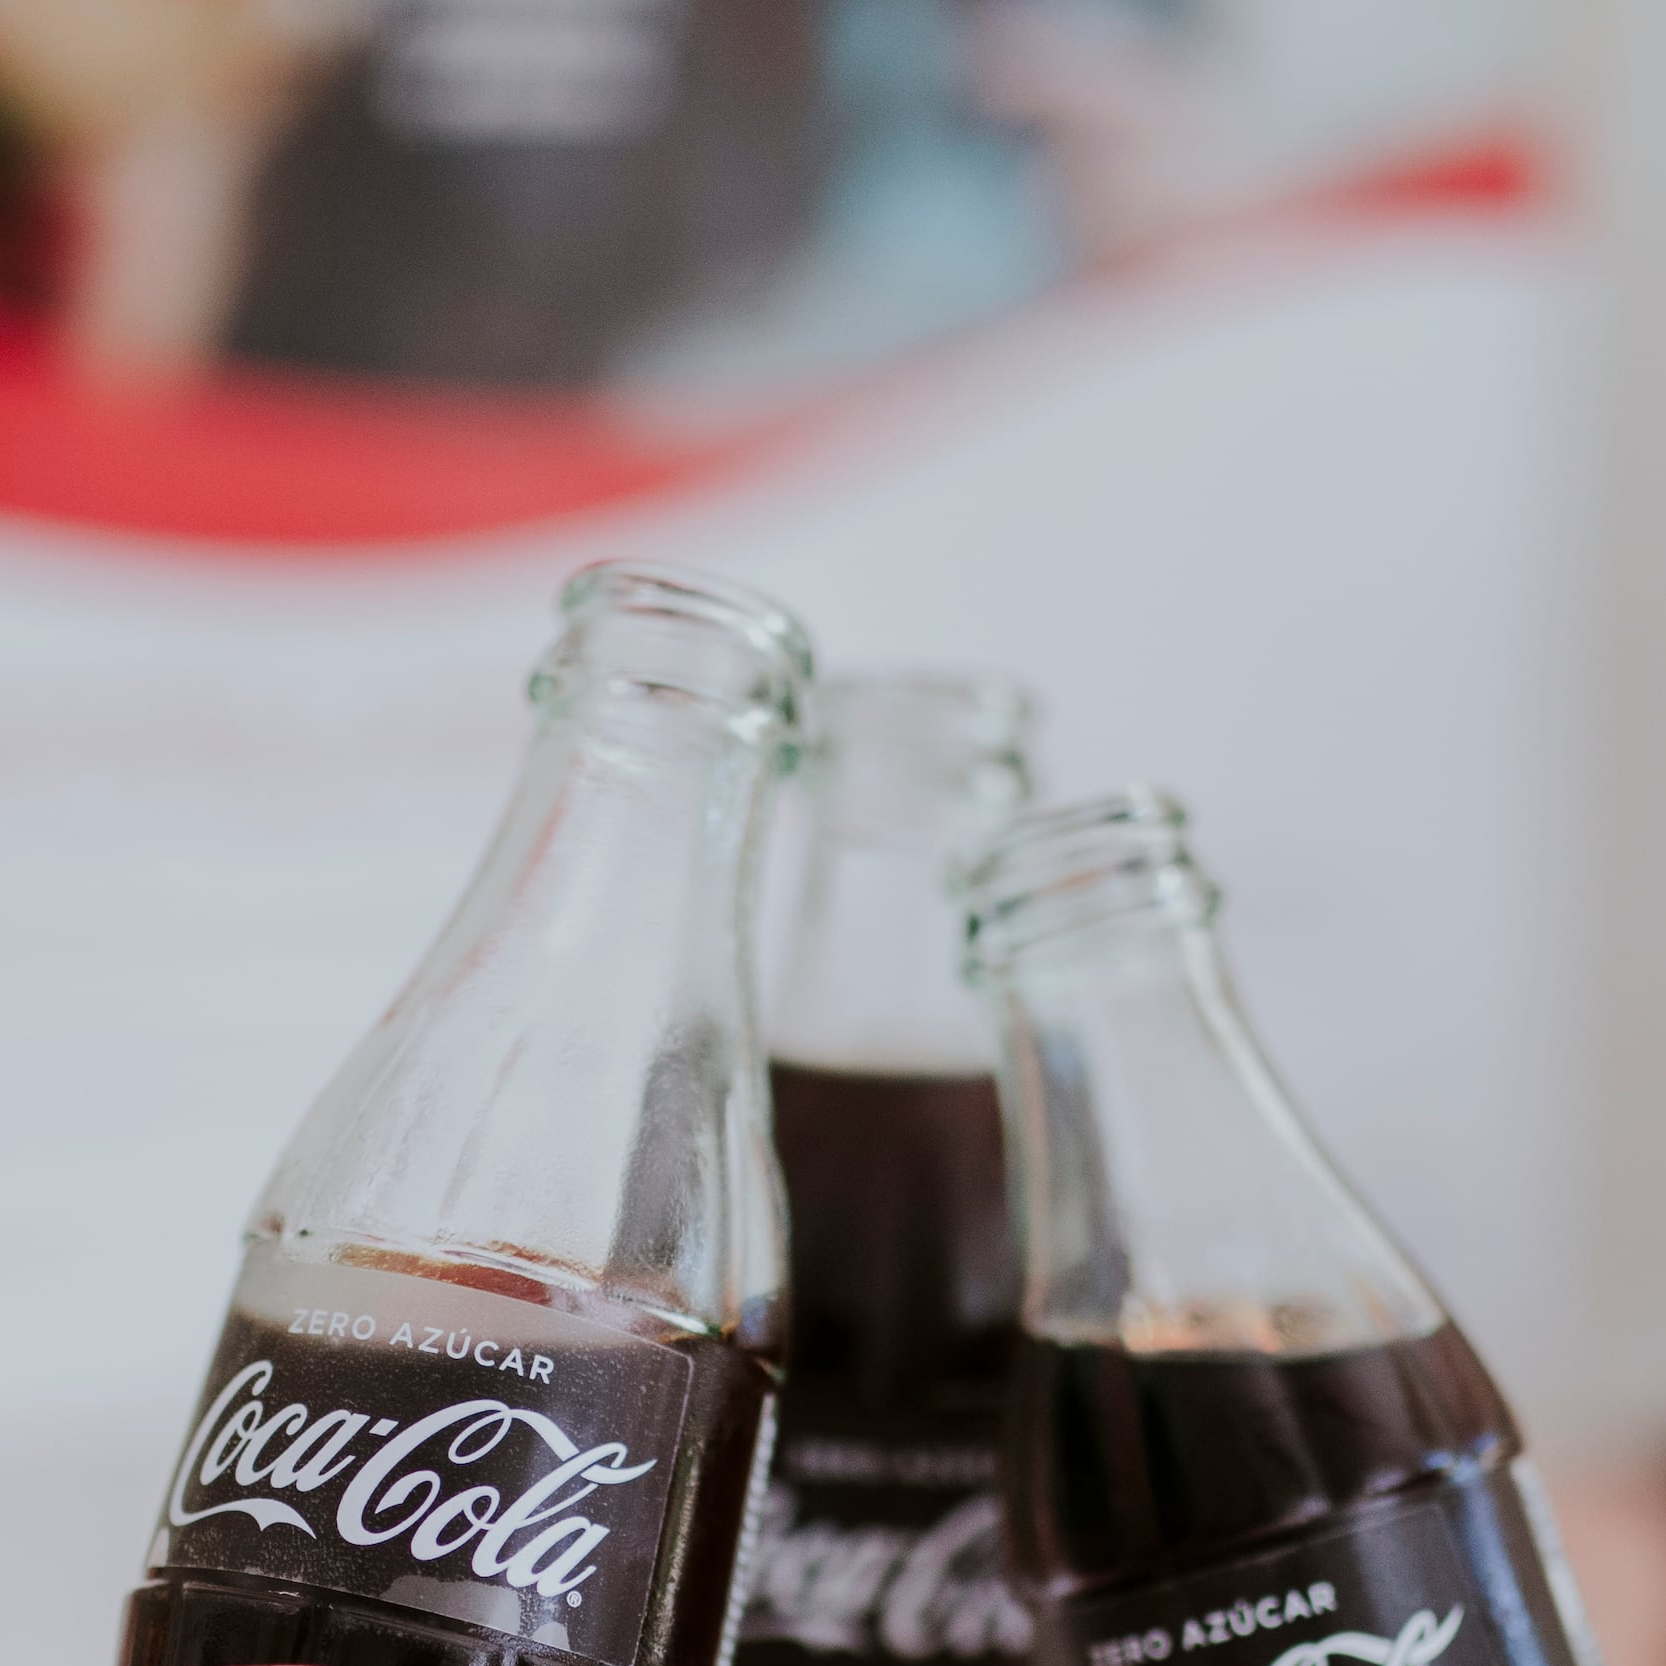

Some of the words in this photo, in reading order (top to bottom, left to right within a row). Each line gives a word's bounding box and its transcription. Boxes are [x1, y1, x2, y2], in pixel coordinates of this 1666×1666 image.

[288, 1309, 376, 1340] ZERO
[389, 1327, 555, 1385] AZÚCAR
[1180, 1580, 1338, 1651] AZÚCAR
